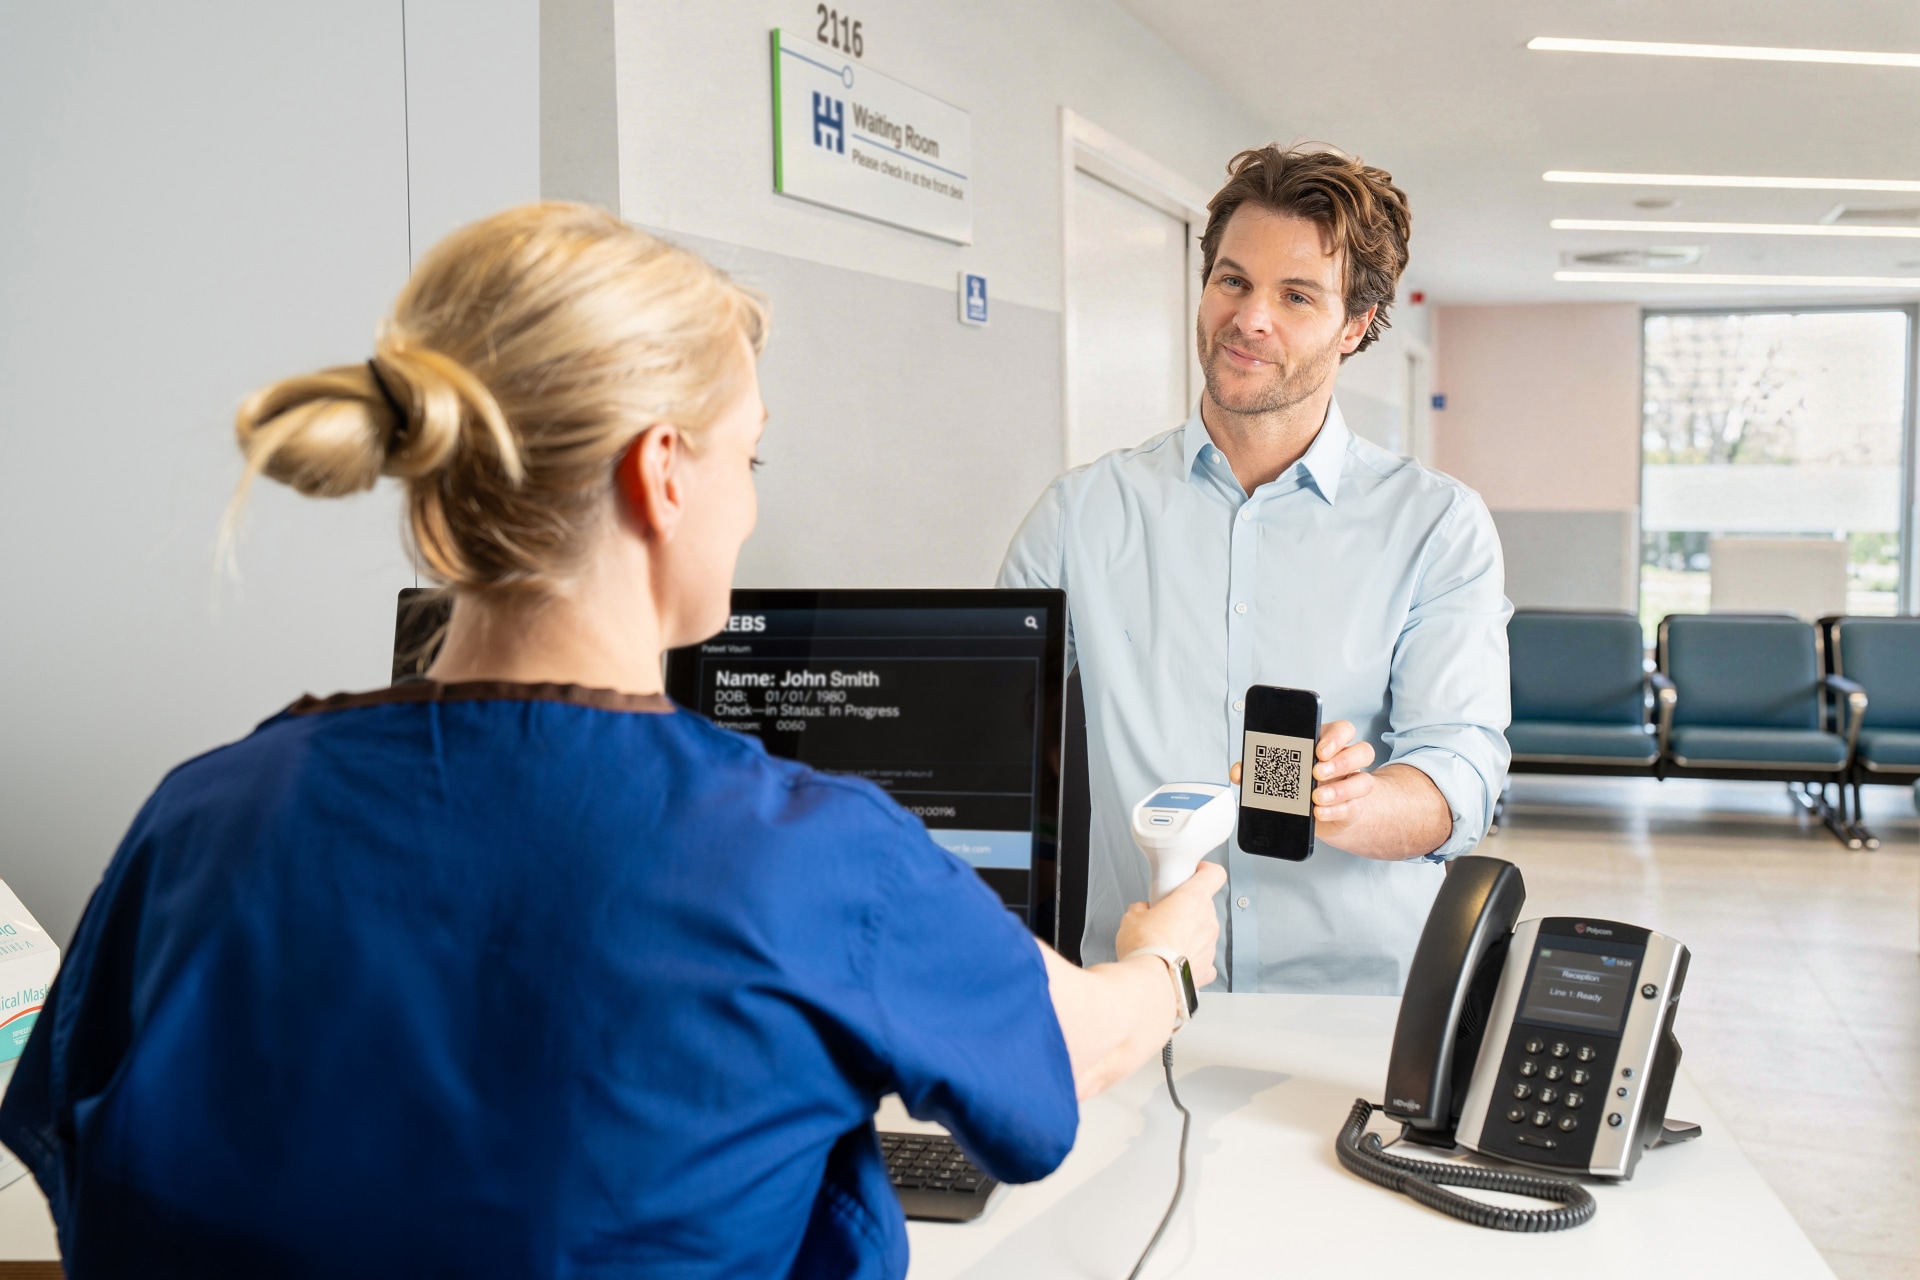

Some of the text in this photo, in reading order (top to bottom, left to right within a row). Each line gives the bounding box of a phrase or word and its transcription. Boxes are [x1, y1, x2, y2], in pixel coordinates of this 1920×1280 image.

[817, 3, 863, 58] 2116
[852, 102, 939, 158] Waiting Room
[852, 149, 964, 201] Please check in at the front desk
[723, 615, 766, 632] EBS
[716, 670, 880, 687] Name: John Smith
[715, 690, 748, 703] DOB:
[817, 690, 847, 703] 1980
[780, 703, 825, 717] Status:
[828, 704, 842, 717] In
[844, 704, 900, 720] Progress
[776, 720, 806, 732] 0060
[1586, 926, 1613, 936] Polycom
[1562, 970, 1600, 982] Reception
[0, 991, 20, 1010] ical
[1549, 988, 1567, 996] Line
[1576, 991, 1603, 1003] Ready
